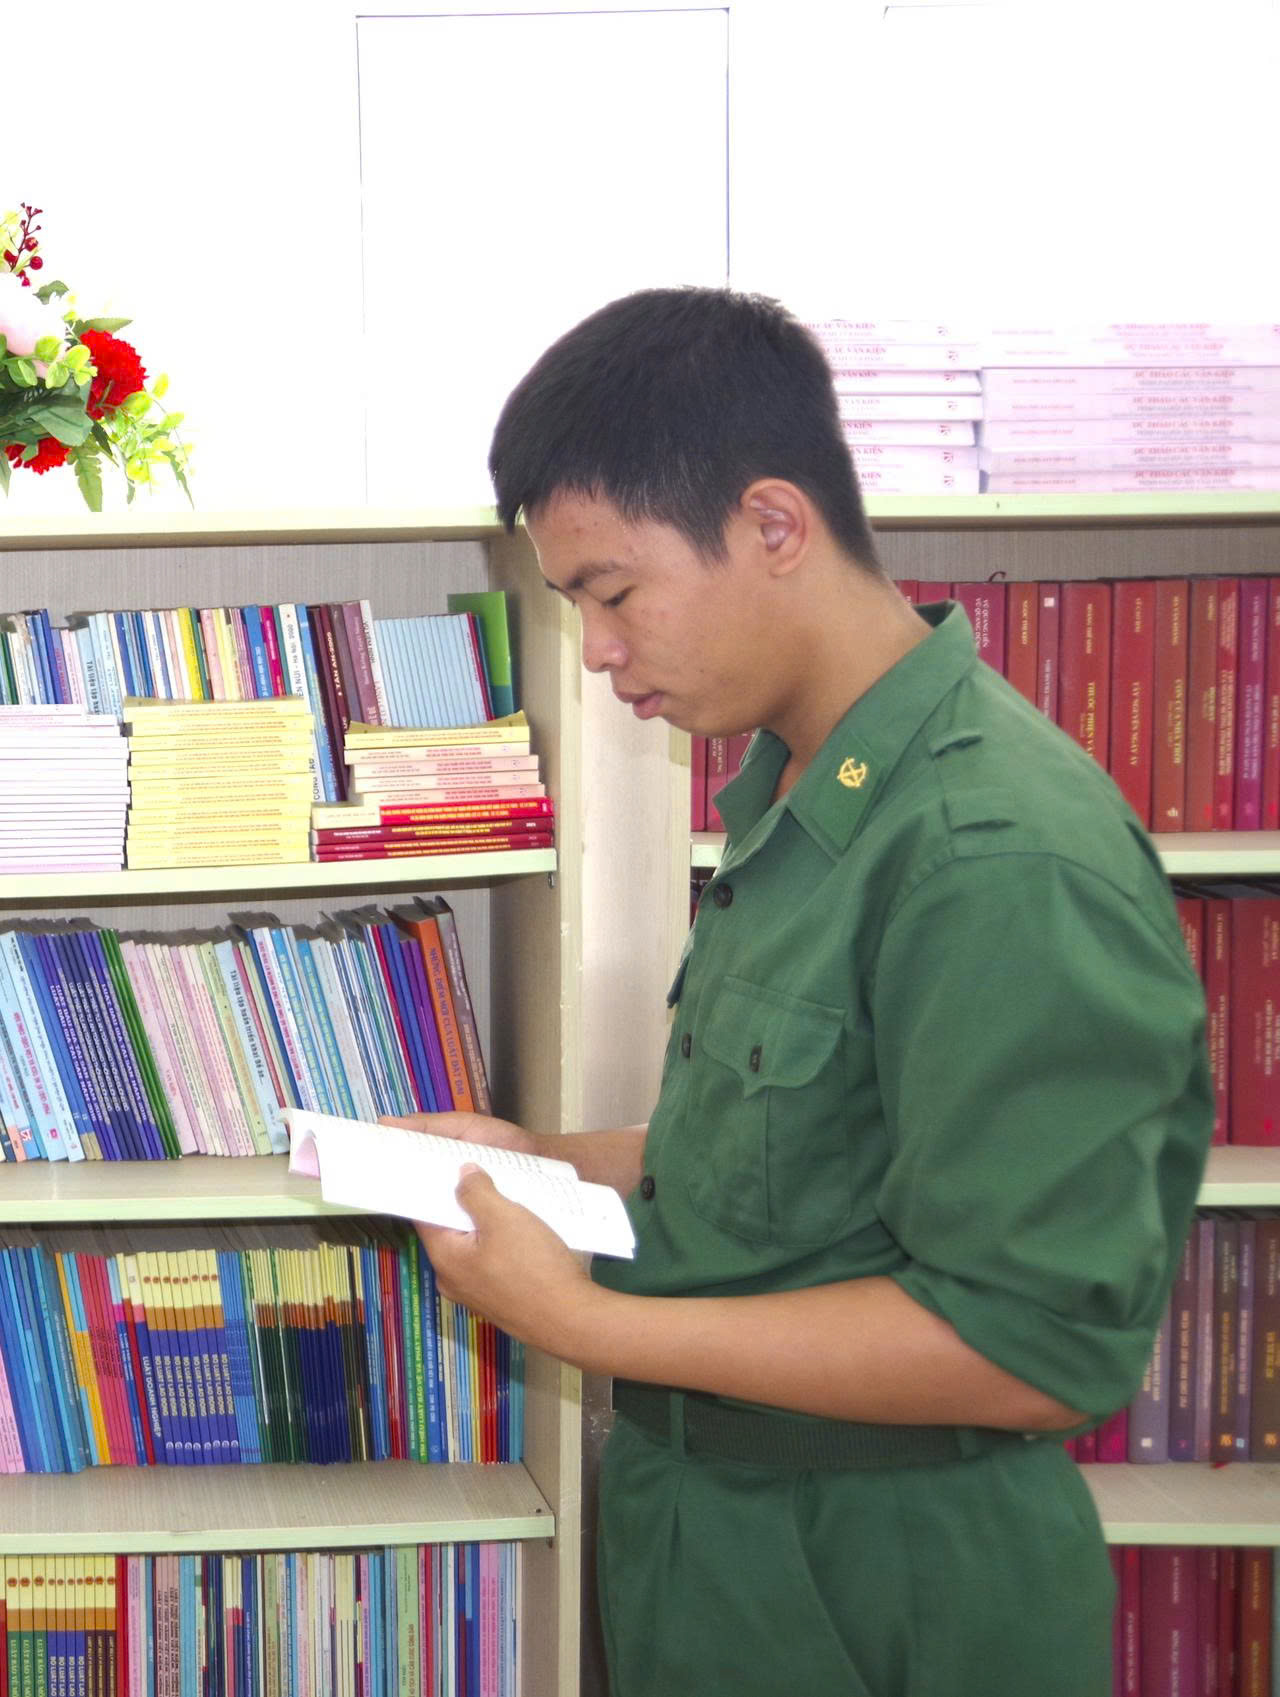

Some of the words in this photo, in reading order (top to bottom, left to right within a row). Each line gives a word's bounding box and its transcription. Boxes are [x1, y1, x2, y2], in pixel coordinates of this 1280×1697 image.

[974, 597, 981, 607] VŨ
[982, 599, 988, 608] VŨ
[332, 669, 340, 689] TÂN
[1087, 739, 1094, 751] VÀ
[428, 947, 441, 977] NHỮNG
[434, 977, 445, 999] ĐIỂM
[438, 999, 449, 1016] MỚI
[442, 1016, 453, 1037] CỦA
[49, 984, 60, 1006] LUẬT
[57, 1008, 66, 1026] ĐẤU
[63, 1028, 72, 1043] GIÁ
[68, 1044, 77, 1059] TÀI
[73, 1060, 83, 1079] SẢN
[80, 1080, 90, 1100] NĂM
[55, 984, 66, 1006] LUẬT
[62, 1008, 73, 1026] ĐẤU
[69, 1027, 78, 1043] GIÁ
[74, 1044, 83, 1059] TÀI
[79, 1060, 90, 1079] SẢN
[85, 1080, 97, 1100] NĂM
[446, 1036, 457, 1058] LUẬT
[450, 1059, 461, 1078] ĐẤT
[454, 1078, 464, 1095] ĐAI
[142, 1355, 152, 1375] LUẬT
[193, 1356, 199, 1365] BỘ
[415, 1363, 421, 1373] VÀ
[194, 1366, 202, 1382] LUẬT
[416, 1375, 422, 1384] VỆ
[145, 1376, 156, 1405] DOANH
[154, 1355, 161, 1365] BỘ
[160, 1397, 168, 1416] ĐỘNG
[174, 1355, 180, 1365] BỘ
[179, 1397, 187, 1416] ĐỘNG
[211, 1354, 218, 1363] BỘ
[217, 1396, 225, 1415] ĐỘNG
[150, 1406, 161, 1437] NGHIỆP
[38, 1675, 45, 1685] VỆ
